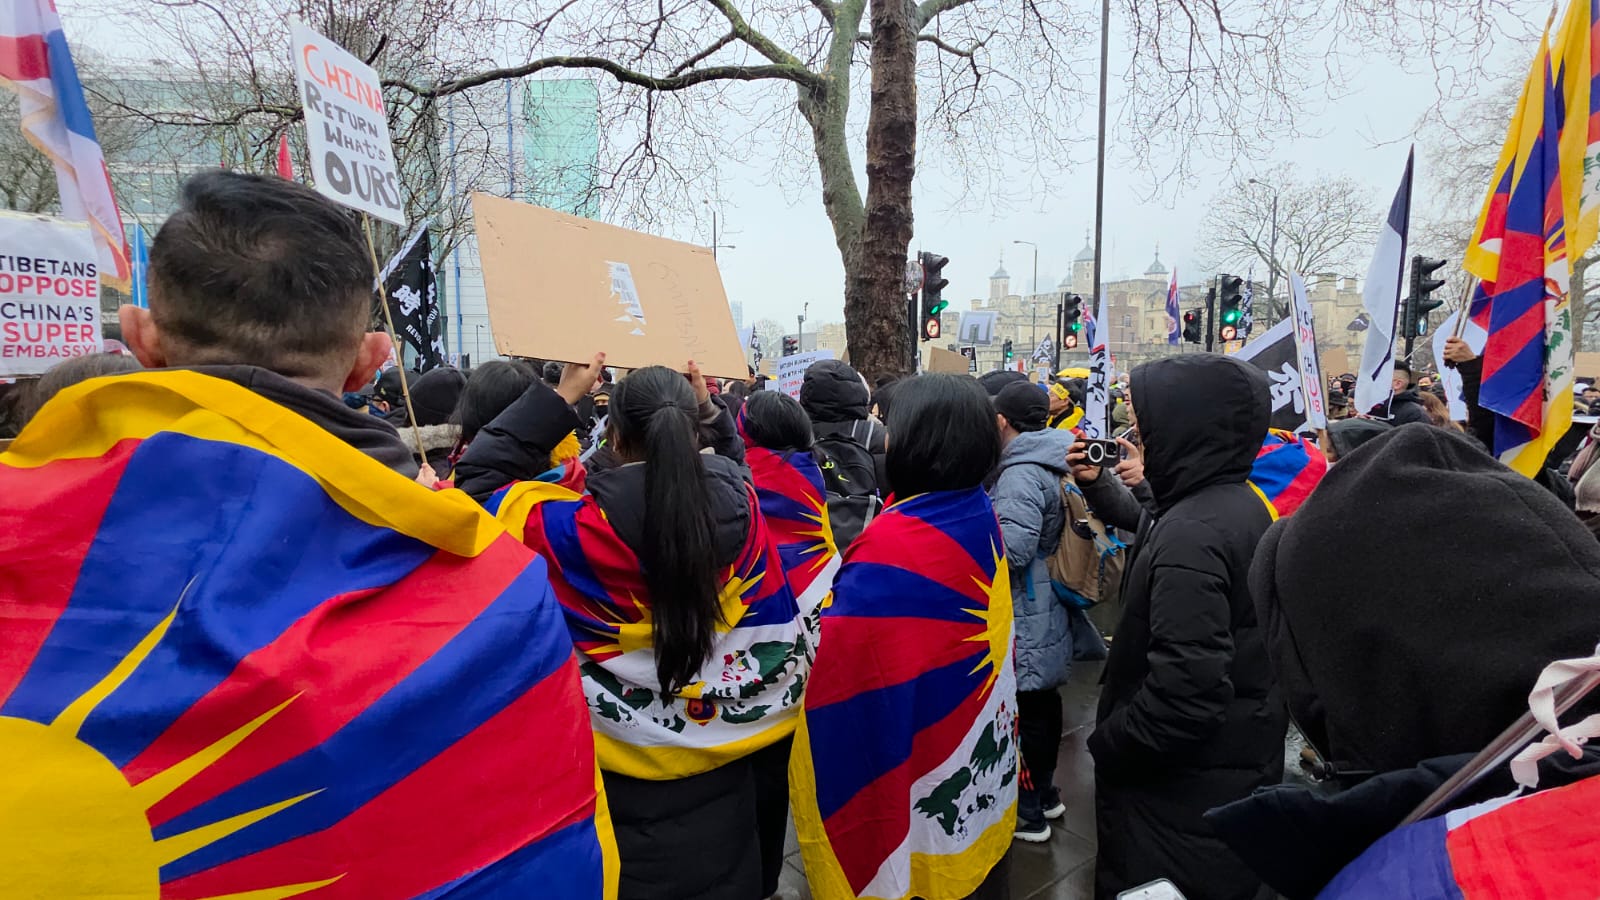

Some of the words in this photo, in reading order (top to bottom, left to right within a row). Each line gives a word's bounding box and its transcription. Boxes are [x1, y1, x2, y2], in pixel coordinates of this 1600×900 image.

[303, 44, 385, 116] CHINA
[304, 80, 378, 138] RETURN
[324, 151, 400, 210] OURS
[0, 273, 97, 298] OPPOSE
[0, 302, 94, 321] CHINA'S
[3, 321, 95, 343] SUPER
